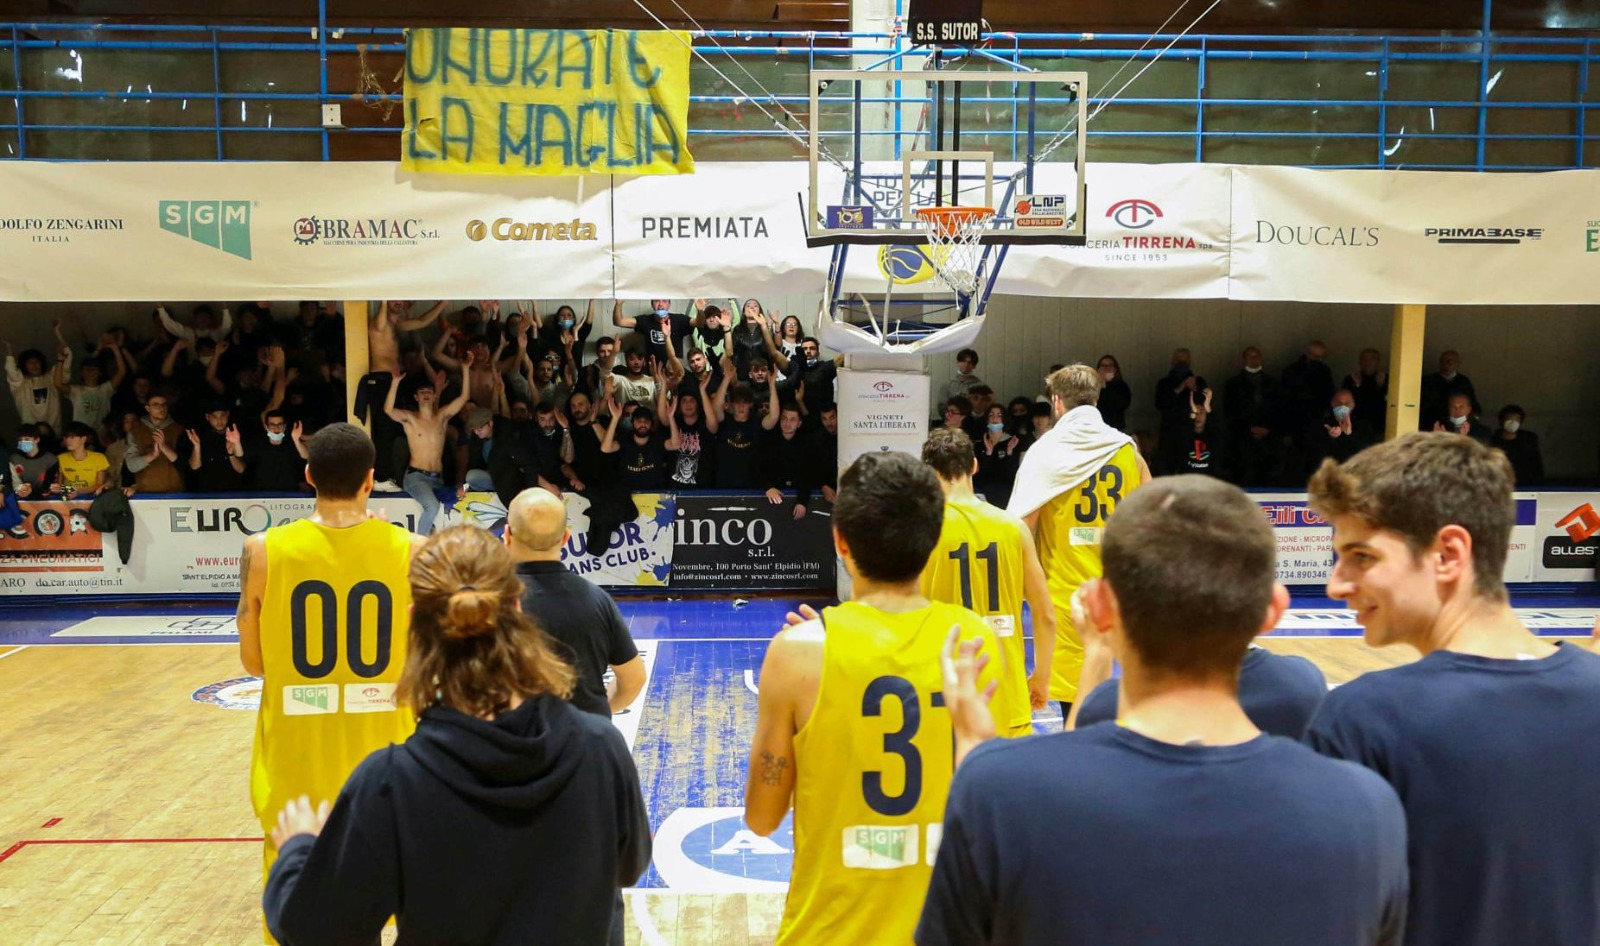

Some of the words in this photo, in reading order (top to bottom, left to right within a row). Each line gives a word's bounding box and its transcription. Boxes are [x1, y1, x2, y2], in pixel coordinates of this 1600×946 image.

[916, 22, 937, 40] S.S.
[941, 22, 979, 40] SUTOR
[409, 96, 473, 163] LA
[499, 100, 681, 168] MAGLIA
[1032, 196, 1064, 207] LNP
[166, 205, 246, 224] SGM
[46, 219, 123, 230] ZENGARINI
[323, 219, 418, 239] BRAMAC
[420, 229, 440, 239] S.r.l.
[491, 217, 598, 241] Cometa
[642, 217, 769, 239] PREMIATA
[1256, 220, 1380, 247] DOUCAL'S
[1425, 228, 1543, 238] PRIMABASE
[1060, 239, 1121, 249] CERIA
[1122, 236, 1196, 249] TIRRENA
[1105, 254, 1137, 262] SINCE
[1143, 254, 1168, 262] 1953
[853, 421, 878, 429] SANTA
[880, 421, 917, 429] LIBERATA
[748, 546, 775, 558] s.r.l.
[21, 553, 101, 564] PNEUMATICI
[1294, 560, 1320, 568] Maria,
[673, 563, 713, 571] Novembre,
[716, 562, 729, 570] 100
[774, 562, 801, 571] Elpidio
[802, 562, 820, 570] (FM)
[750, 572, 819, 580] www.zincosrl.com
[949, 541, 1000, 612] 11
[36, 577, 123, 589] do.car.auto@tin.it
[290, 579, 394, 679] 00
[294, 687, 328, 699] SGM
[857, 830, 907, 845] SGM
